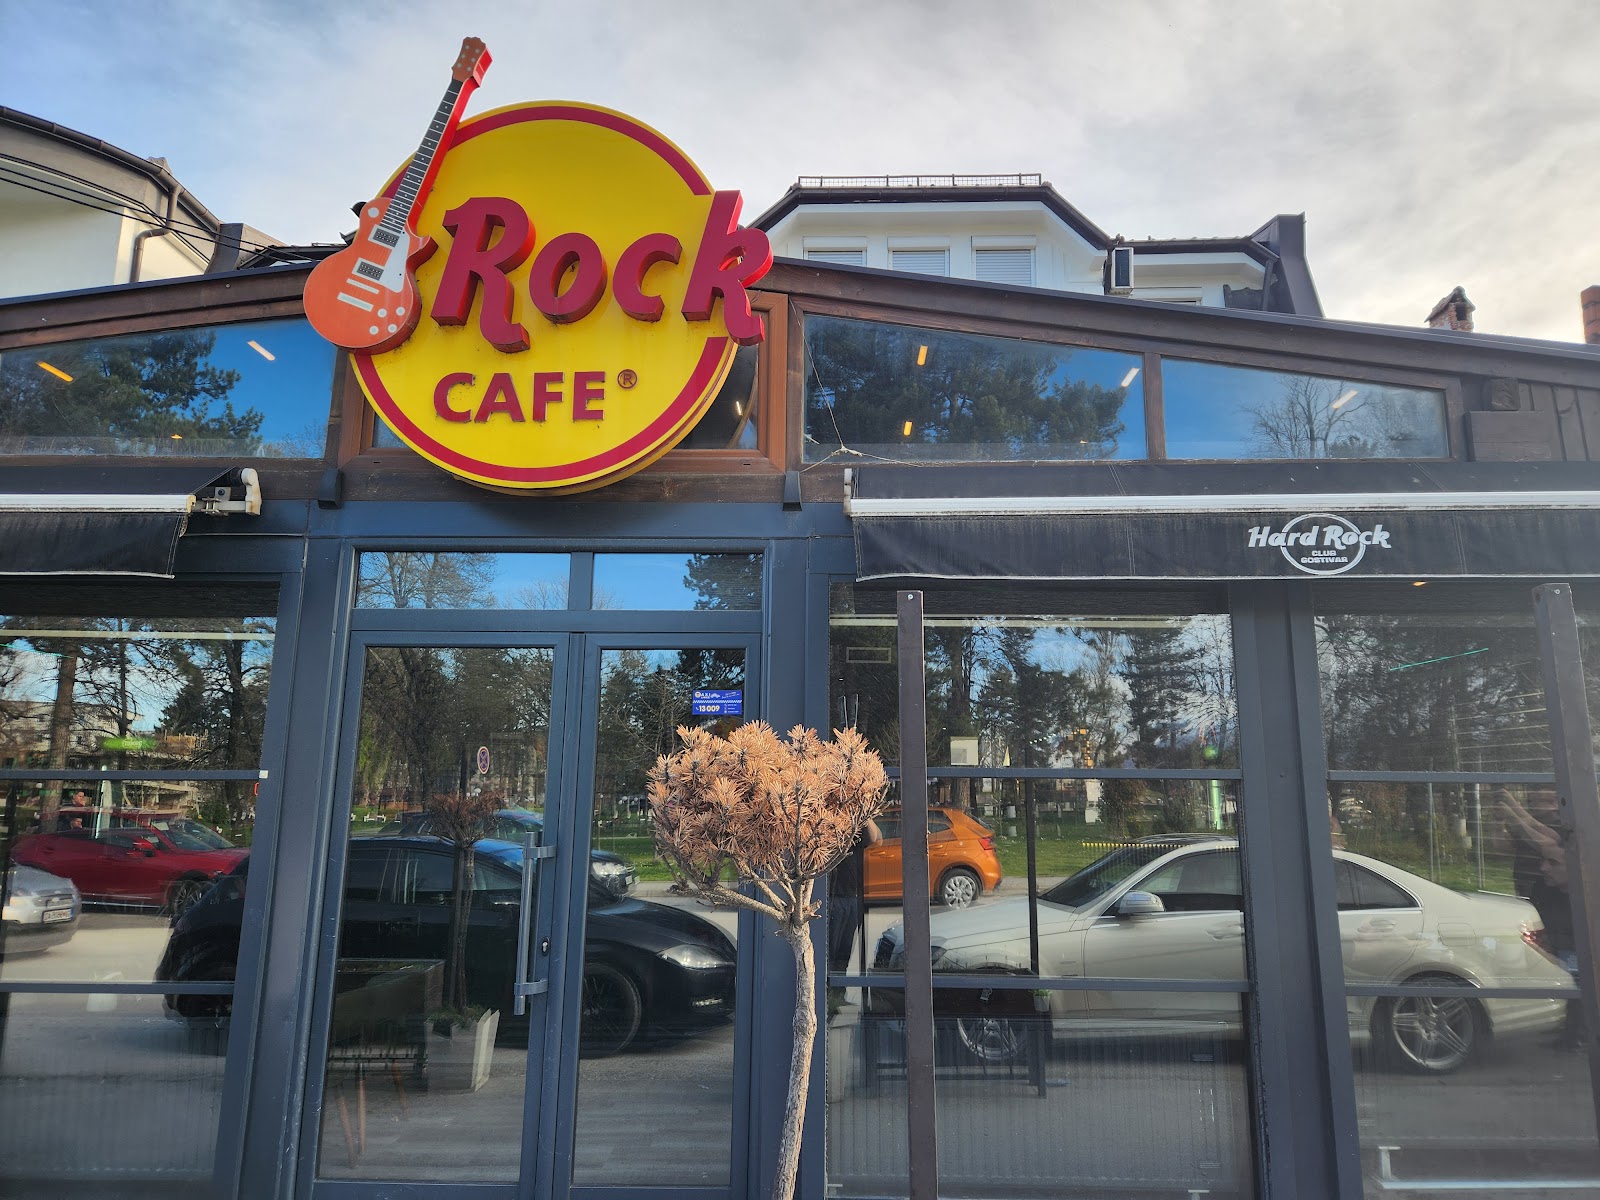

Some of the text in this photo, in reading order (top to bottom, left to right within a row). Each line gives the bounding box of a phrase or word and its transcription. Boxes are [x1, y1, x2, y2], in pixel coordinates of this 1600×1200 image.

[430, 189, 774, 353] Rock
[433, 371, 606, 423] CAFE
[1248, 524, 1392, 550] Hard Rock
[1300, 556, 1349, 564] GOSTIVAR
